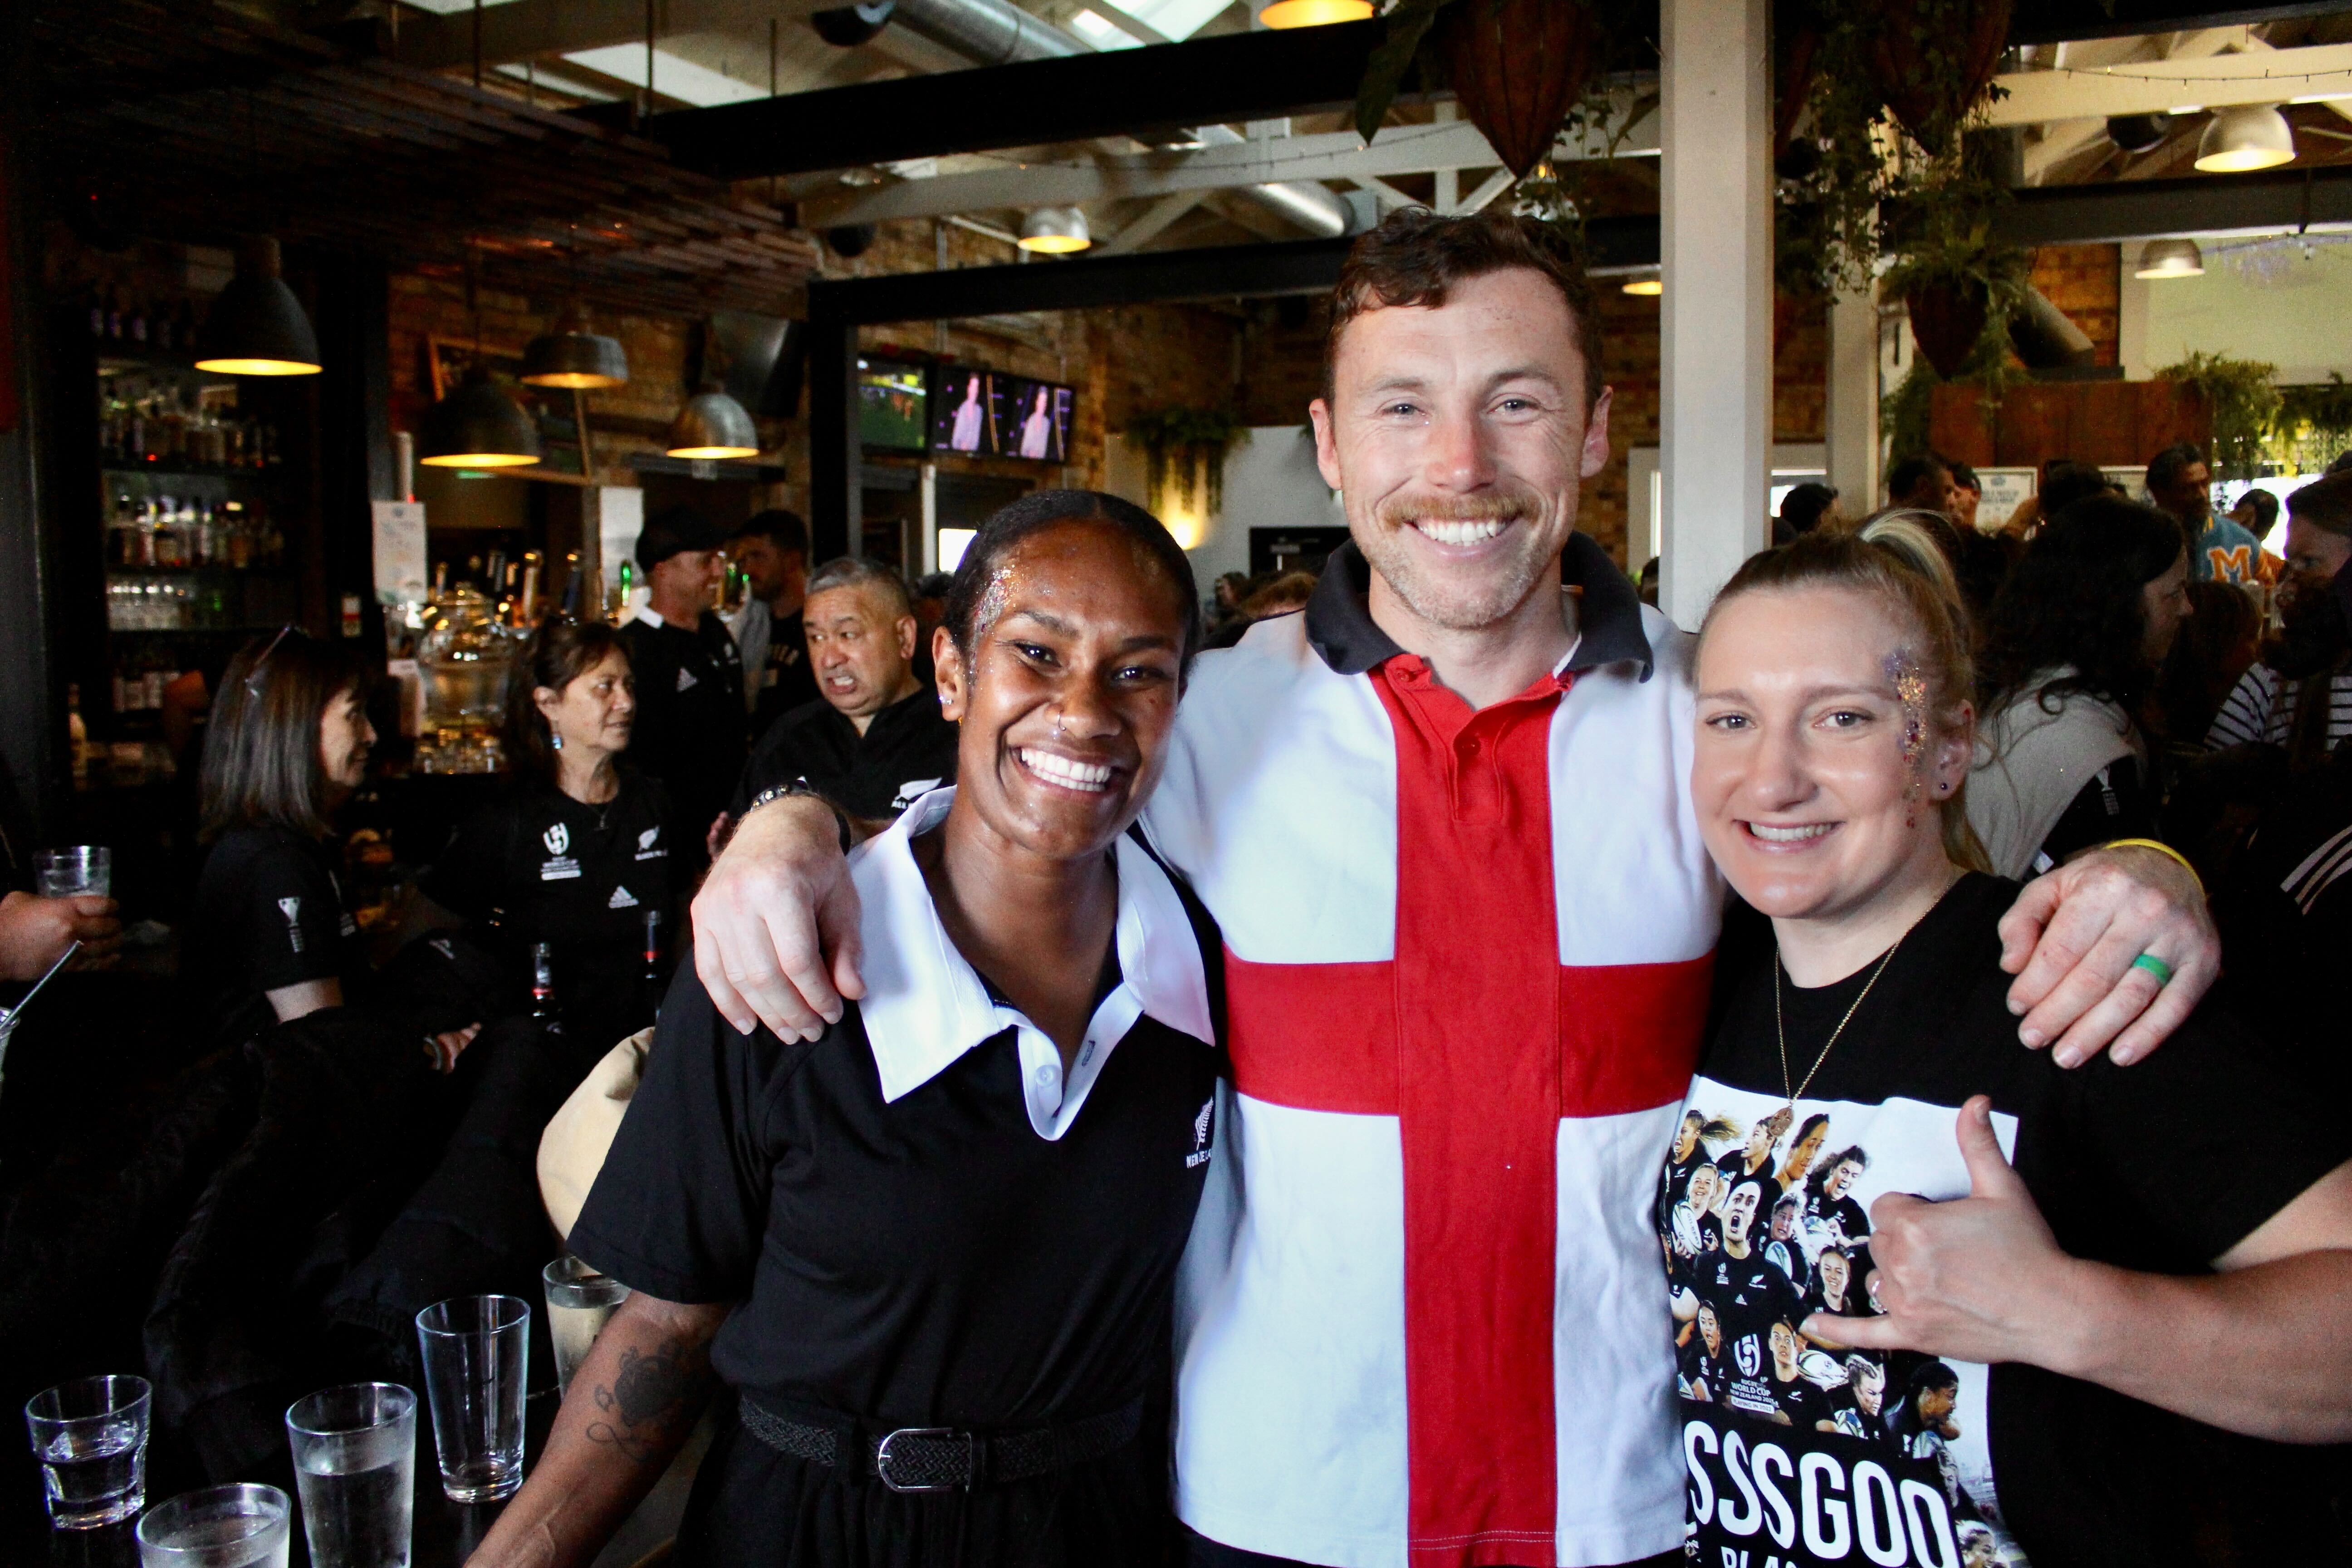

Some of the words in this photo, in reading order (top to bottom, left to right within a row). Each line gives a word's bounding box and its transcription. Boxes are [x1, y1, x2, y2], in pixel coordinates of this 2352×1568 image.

[2207, 545, 2251, 583] M
[1731, 1382, 1756, 1394] WORLD
[1756, 1387, 1771, 1396] CUP
[1740, 1392, 1762, 1401] ZEALAND
